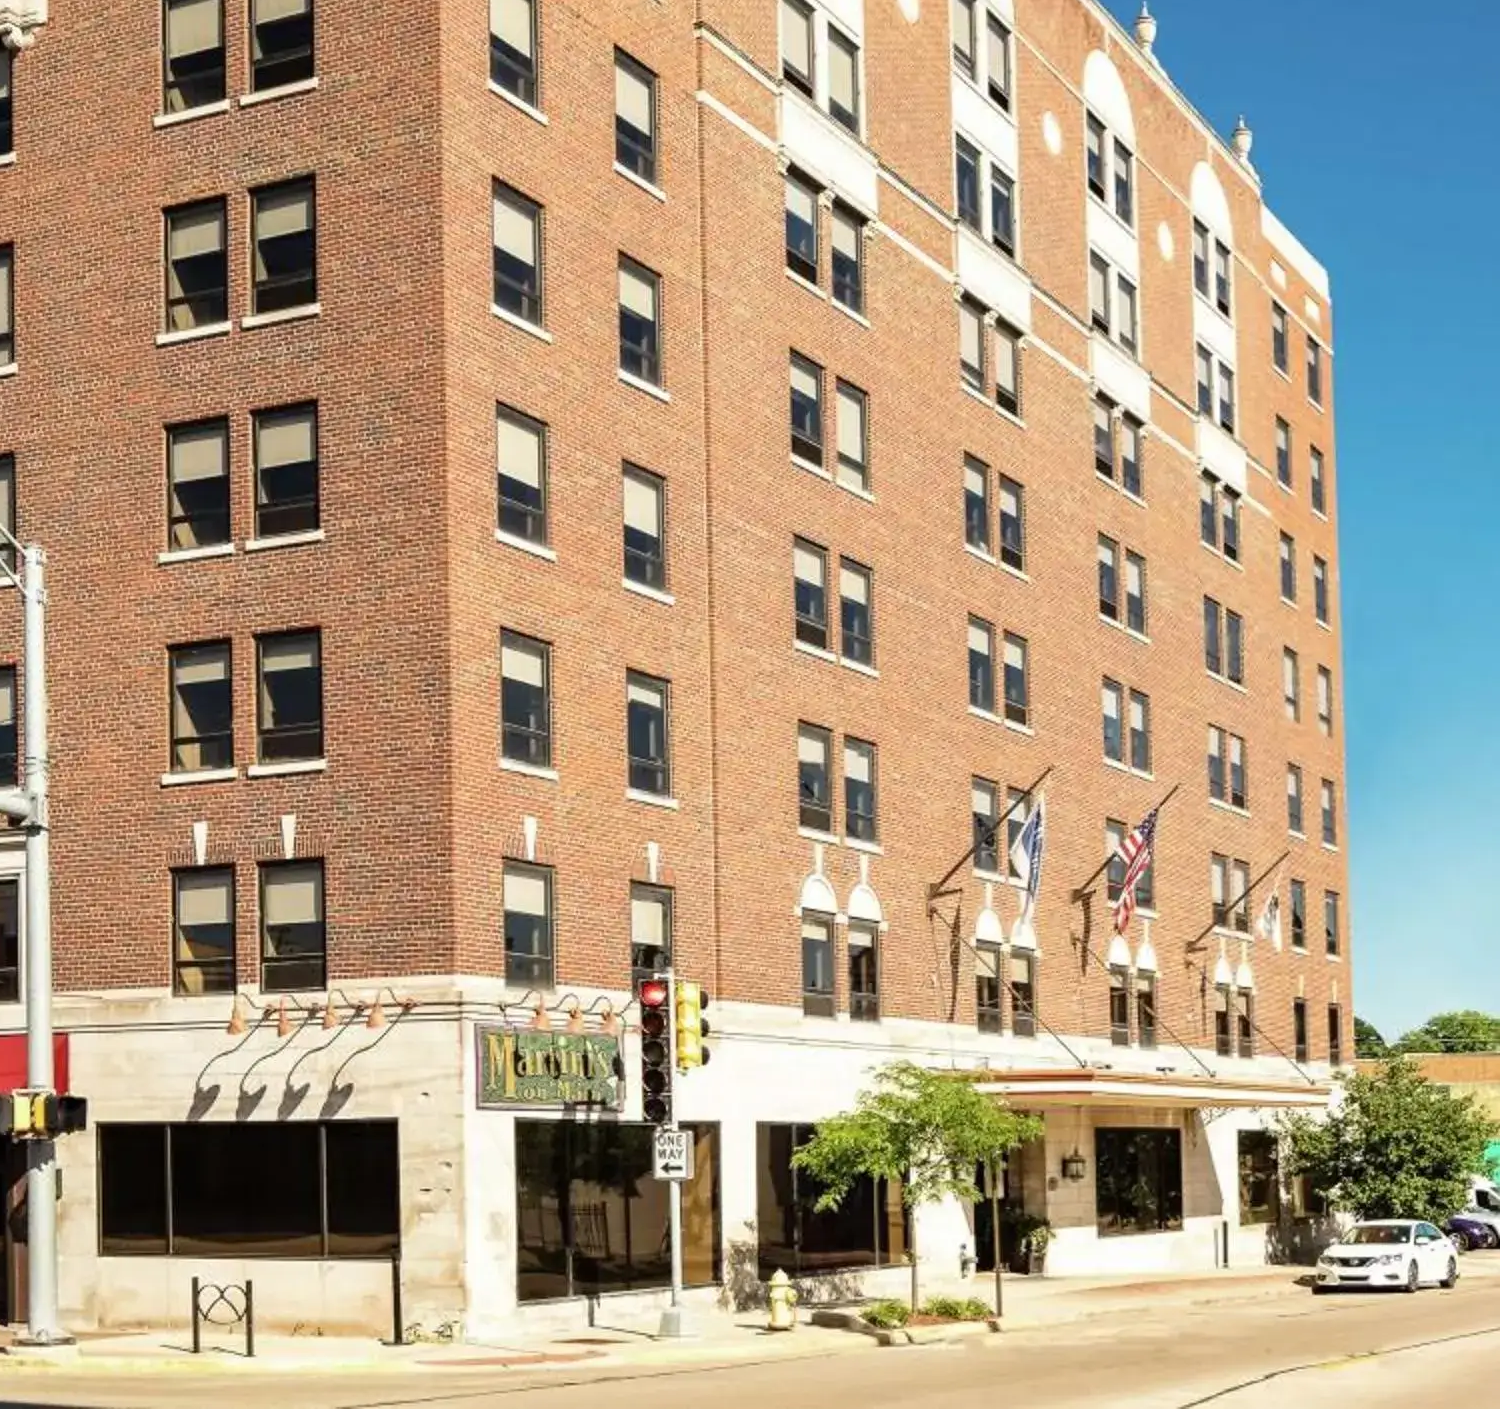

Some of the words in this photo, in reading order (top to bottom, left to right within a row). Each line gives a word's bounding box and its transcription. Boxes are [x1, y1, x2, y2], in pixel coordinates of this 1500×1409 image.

[523, 1086, 547, 1100] on
[657, 1134, 684, 1147] ONE
[657, 1148, 685, 1160] WAY
